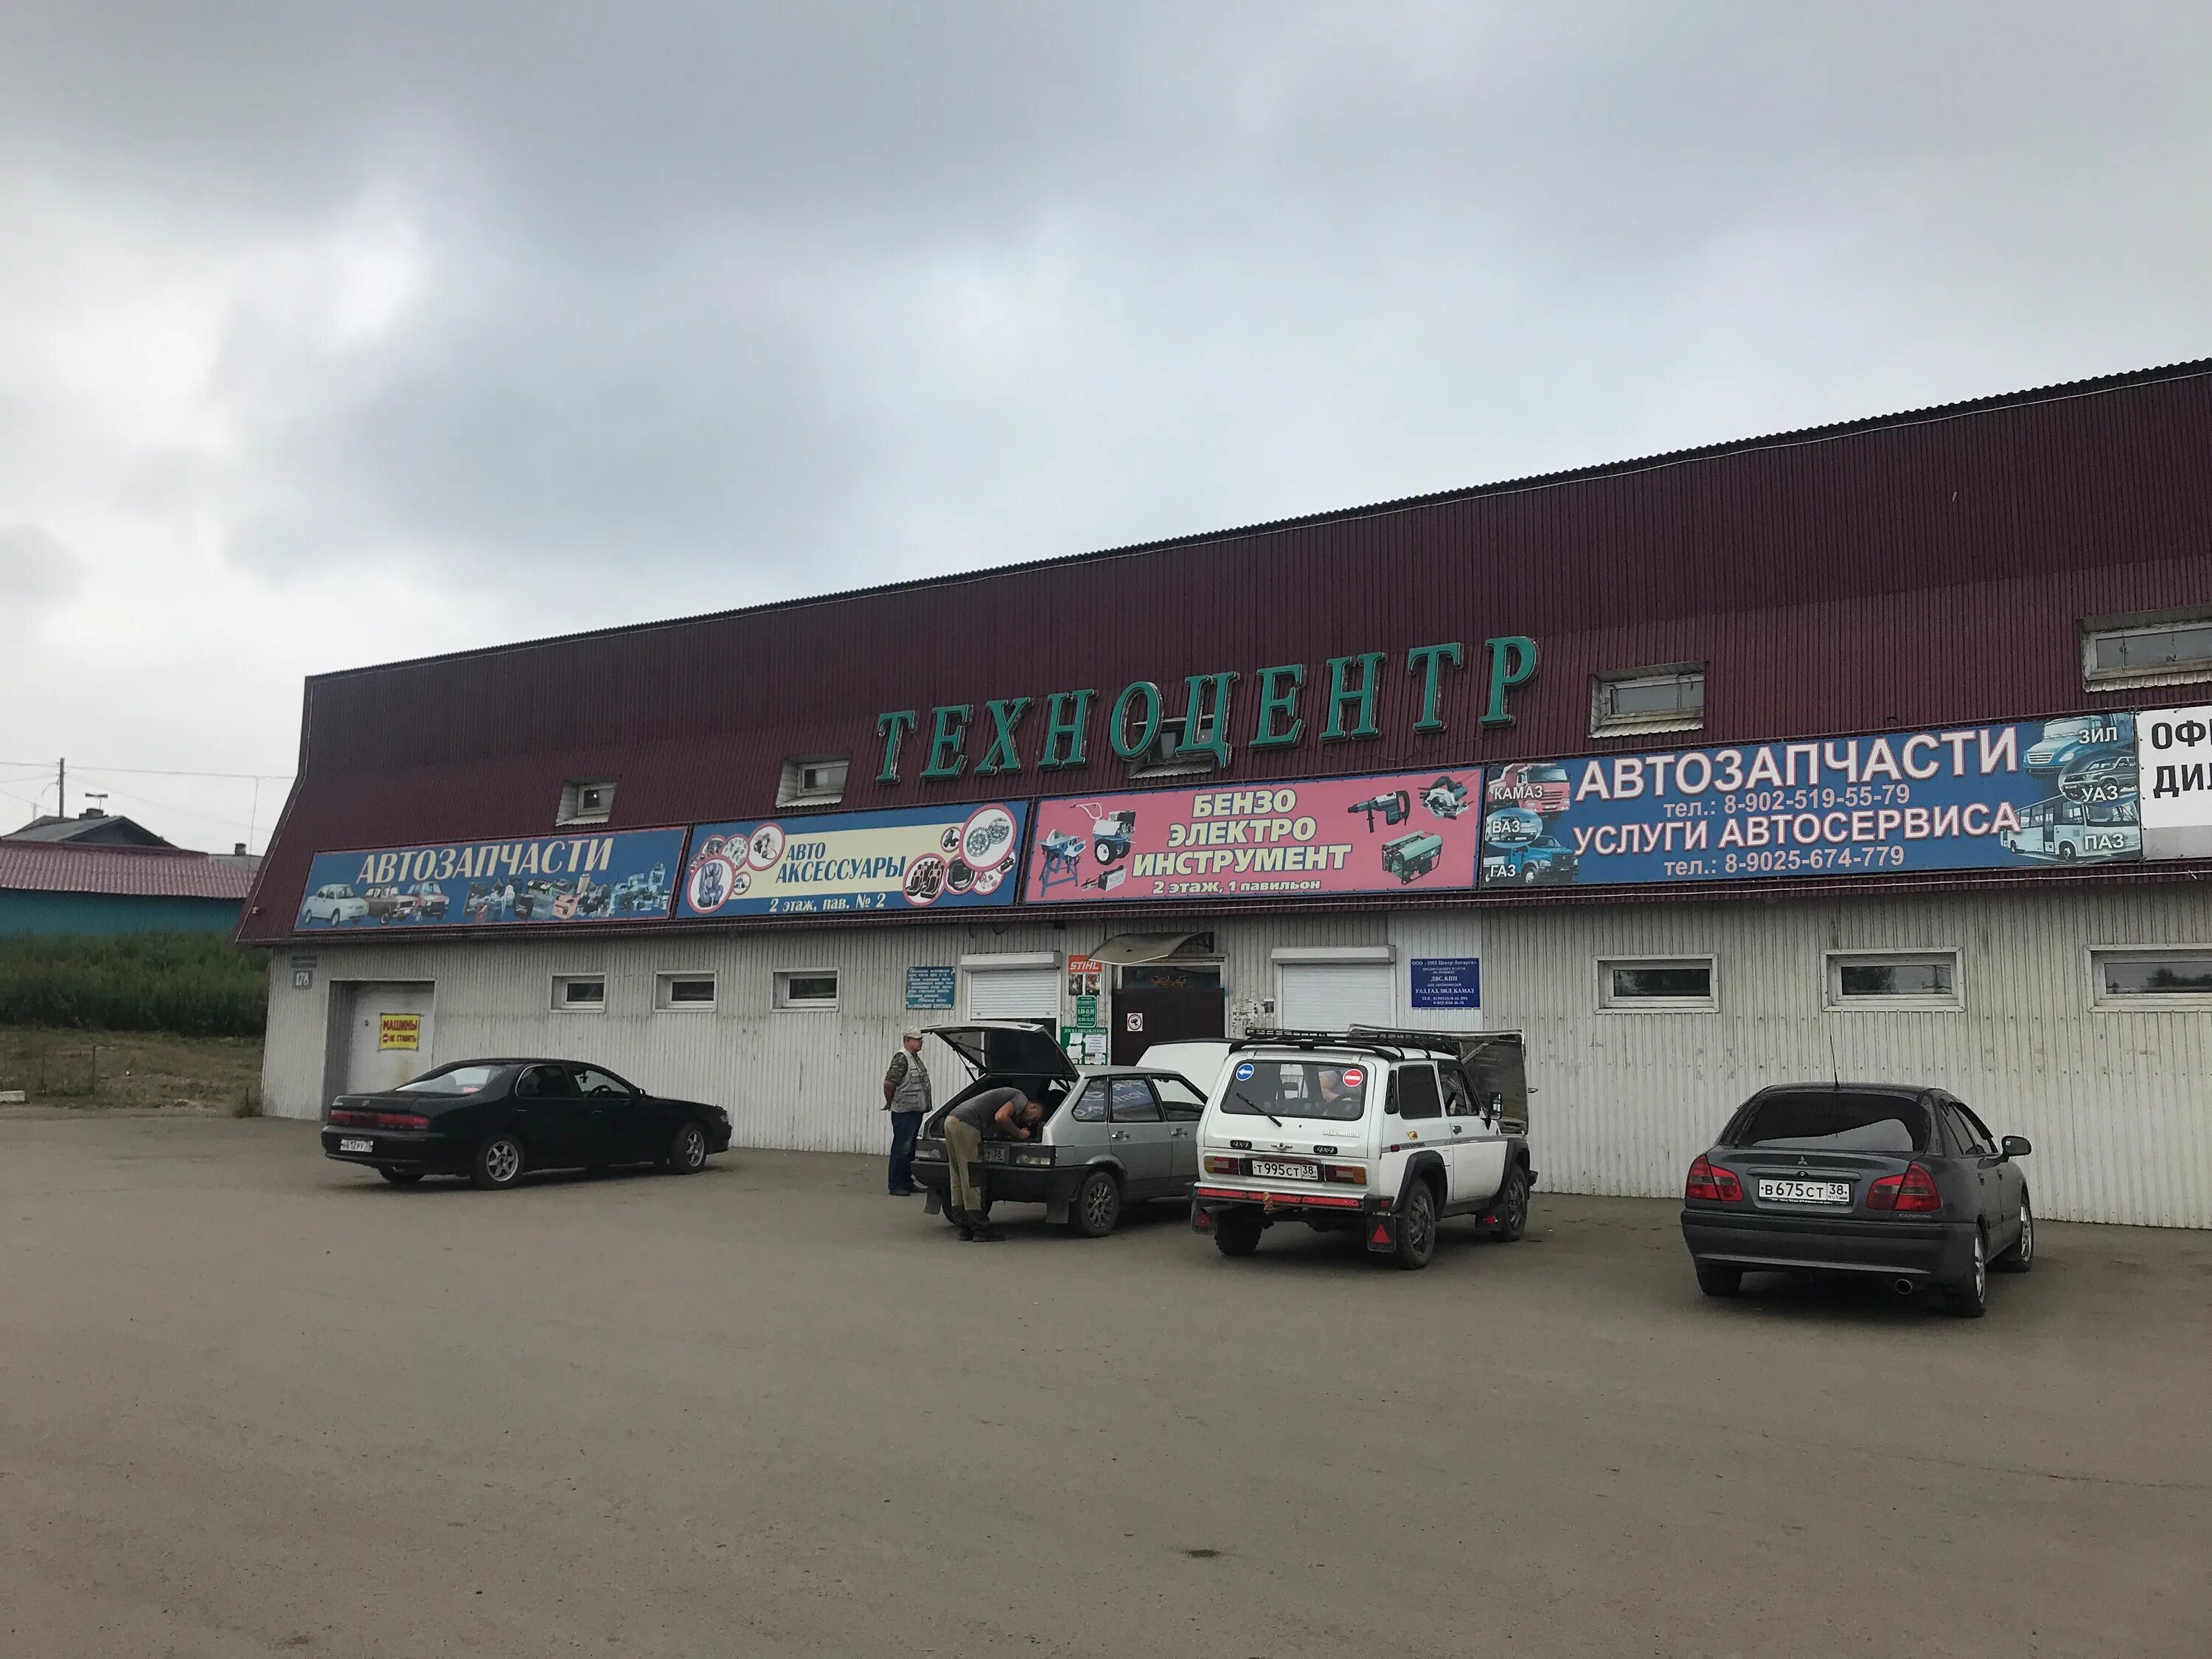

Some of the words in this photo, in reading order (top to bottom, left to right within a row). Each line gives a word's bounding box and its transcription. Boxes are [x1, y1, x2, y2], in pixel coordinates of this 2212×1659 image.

[875, 635, 1540, 785] ТЕХНОЦЕНТР
[2079, 727, 2118, 743] ЗИЛ
[1575, 726, 2018, 801] АВТОЗАПЧАСТИ
[2153, 763, 2212, 799] ДИ
[1494, 785, 1543, 800] КАМАЗ
[1663, 799, 1716, 818] тел.:
[1724, 784, 1910, 815] 8-902-519-55-79
[2082, 786, 2118, 802] УАЗ
[1192, 789, 1297, 818] БЕНЗО
[1168, 817, 1317, 847] ЭЛЕКТРО
[1492, 819, 1520, 833] ВАЗ
[1573, 820, 1708, 855] УСЛУГИ
[1718, 801, 2021, 849] АВТОСЕРВИСА
[786, 842, 826, 860] АВТО
[2084, 834, 2124, 850] ПАЗ
[356, 838, 613, 885] АВТОЗАПЧАСТИ
[1133, 844, 1352, 877] ИНСТРУМЕНТ
[1664, 859, 1716, 875] тел.:
[1725, 845, 1905, 873] 8-9025-674-779
[776, 856, 905, 884] АКСЕССУАРЫ
[1490, 864, 1516, 878] ГАЗ
[1152, 881, 1164, 894] 2
[1169, 881, 1223, 894] этаж,
[1228, 881, 1237, 892] 1
[1239, 879, 1321, 891] павильон
[770, 899, 779, 913] 2
[783, 897, 817, 913] этаж,
[823, 897, 849, 910] пав.
[855, 894, 871, 908] №
[875, 893, 885, 908] 2
[1070, 961, 1099, 970] STIHL
[383, 1019, 418, 1031] МАШИНЫ
[1302, 1166, 1313, 1175] 38
[1829, 1184, 1843, 1194] 38
